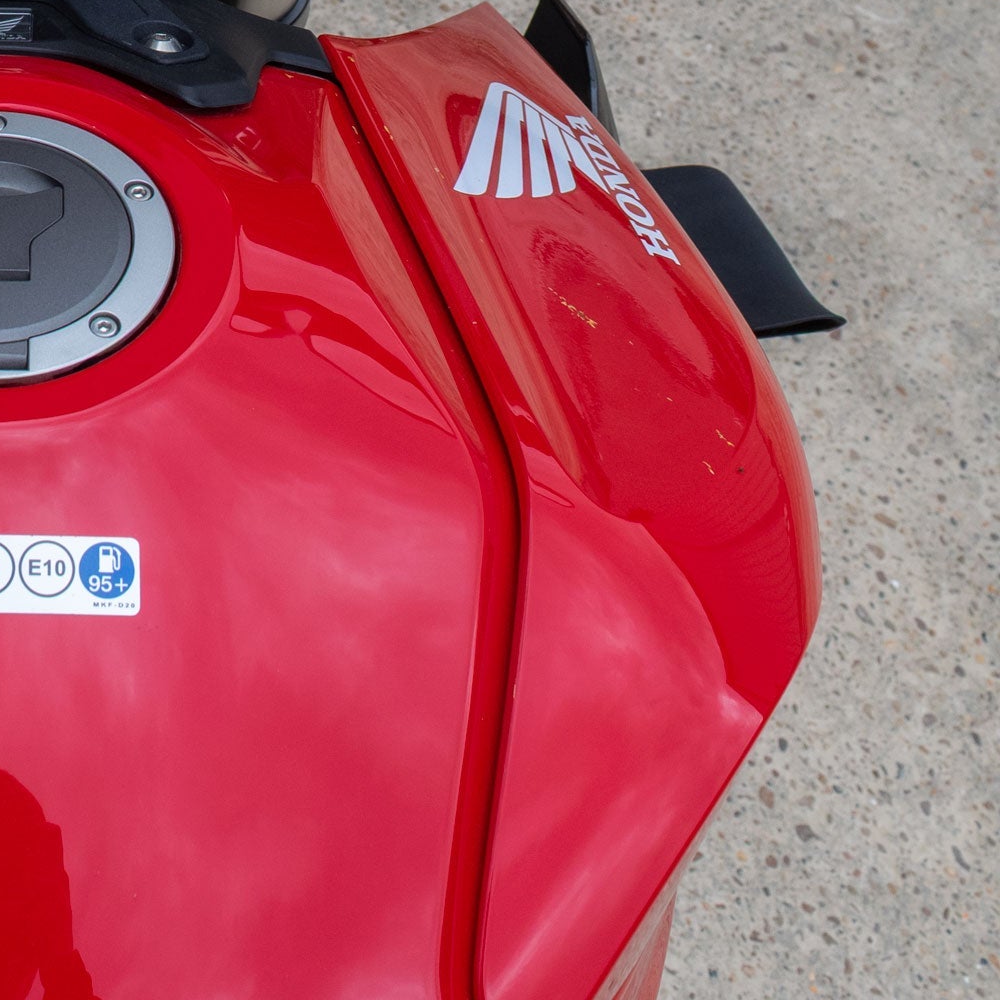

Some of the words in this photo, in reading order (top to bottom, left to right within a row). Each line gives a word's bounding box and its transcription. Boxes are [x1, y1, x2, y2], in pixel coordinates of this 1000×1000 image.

[565, 114, 681, 266] HONDA
[28, 558, 66, 577] E10
[88, 575, 129, 593] 95+
